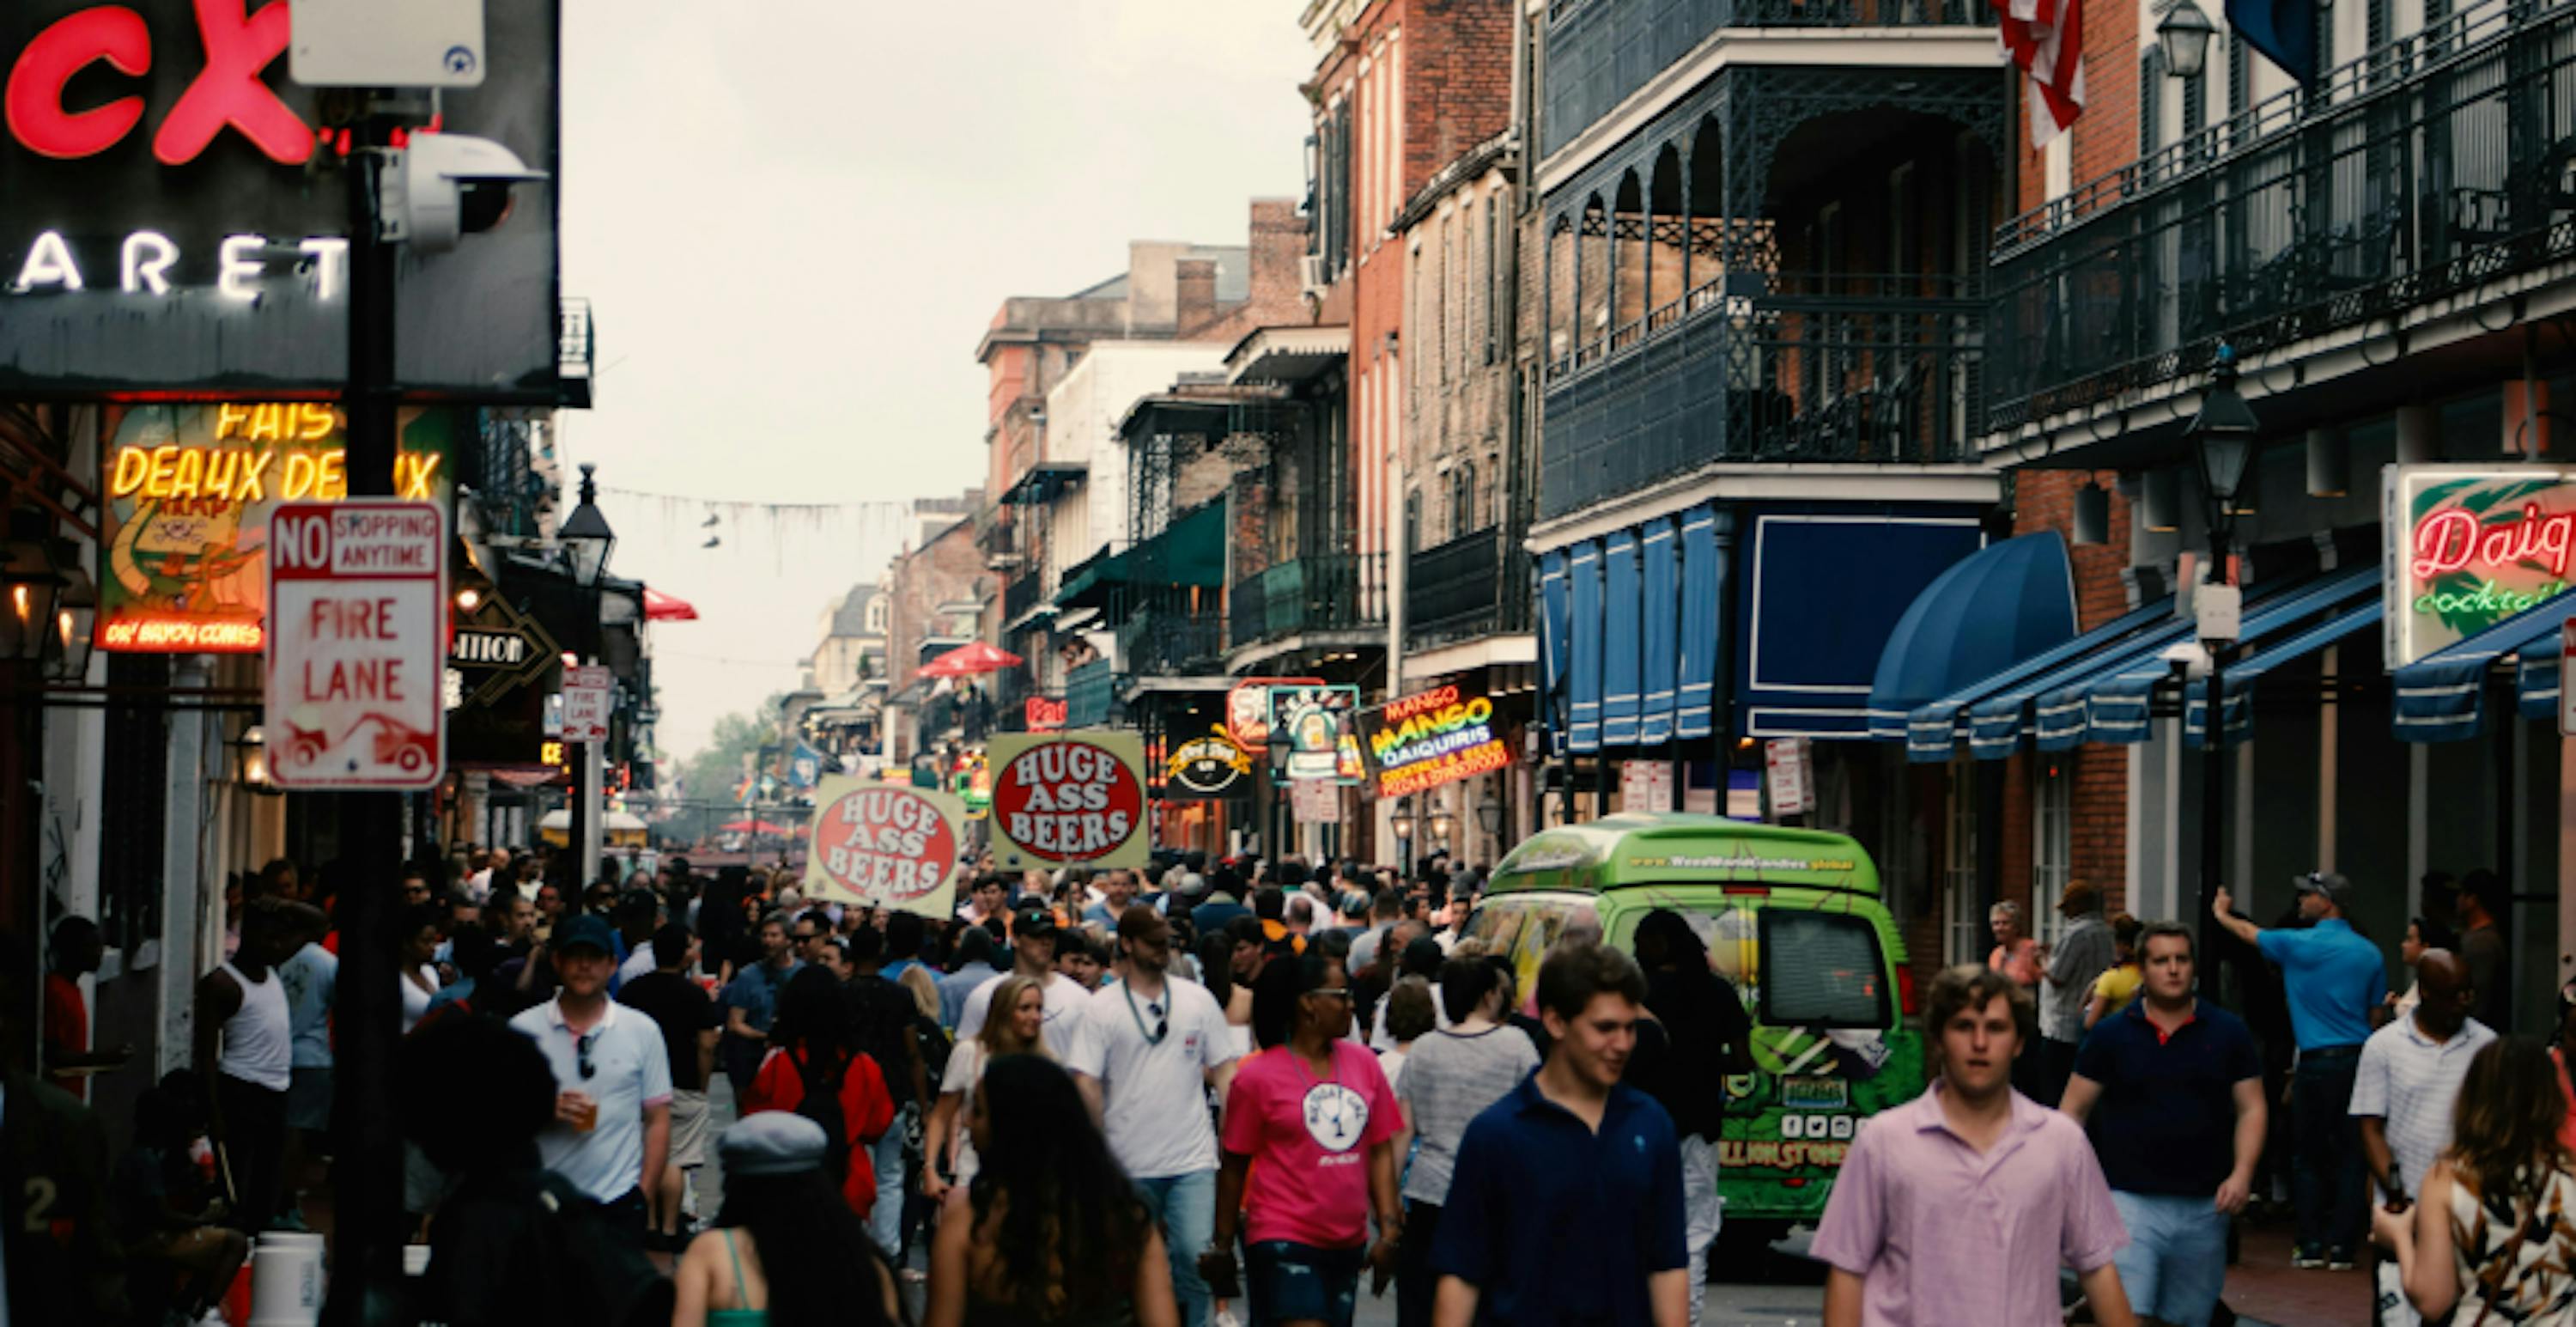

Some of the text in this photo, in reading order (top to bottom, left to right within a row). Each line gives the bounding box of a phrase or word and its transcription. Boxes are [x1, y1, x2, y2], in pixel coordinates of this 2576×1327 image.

[15, 229, 349, 301] ARET
[112, 445, 274, 502] DEAUX
[274, 514, 331, 569] NO
[335, 514, 437, 538] STOPPING
[2412, 503, 2572, 580] Daiq
[340, 544, 427, 568] ANYTIME
[310, 598, 398, 641] FIRE
[453, 633, 525, 663] ITION
[304, 659, 404, 703] LANE
[1385, 685, 1459, 722] MANGO
[1371, 697, 1493, 758] MANGO
[1383, 725, 1491, 766] DAIQUIRIS
[1015, 745, 1118, 787] HUGE
[841, 791, 939, 837] HUGE
[1024, 782, 1109, 813] ASS
[844, 824, 926, 859] ASS
[1010, 810, 1129, 853] BEERS
[827, 847, 940, 894] BEERS
[24, 1176, 57, 1232] 2
